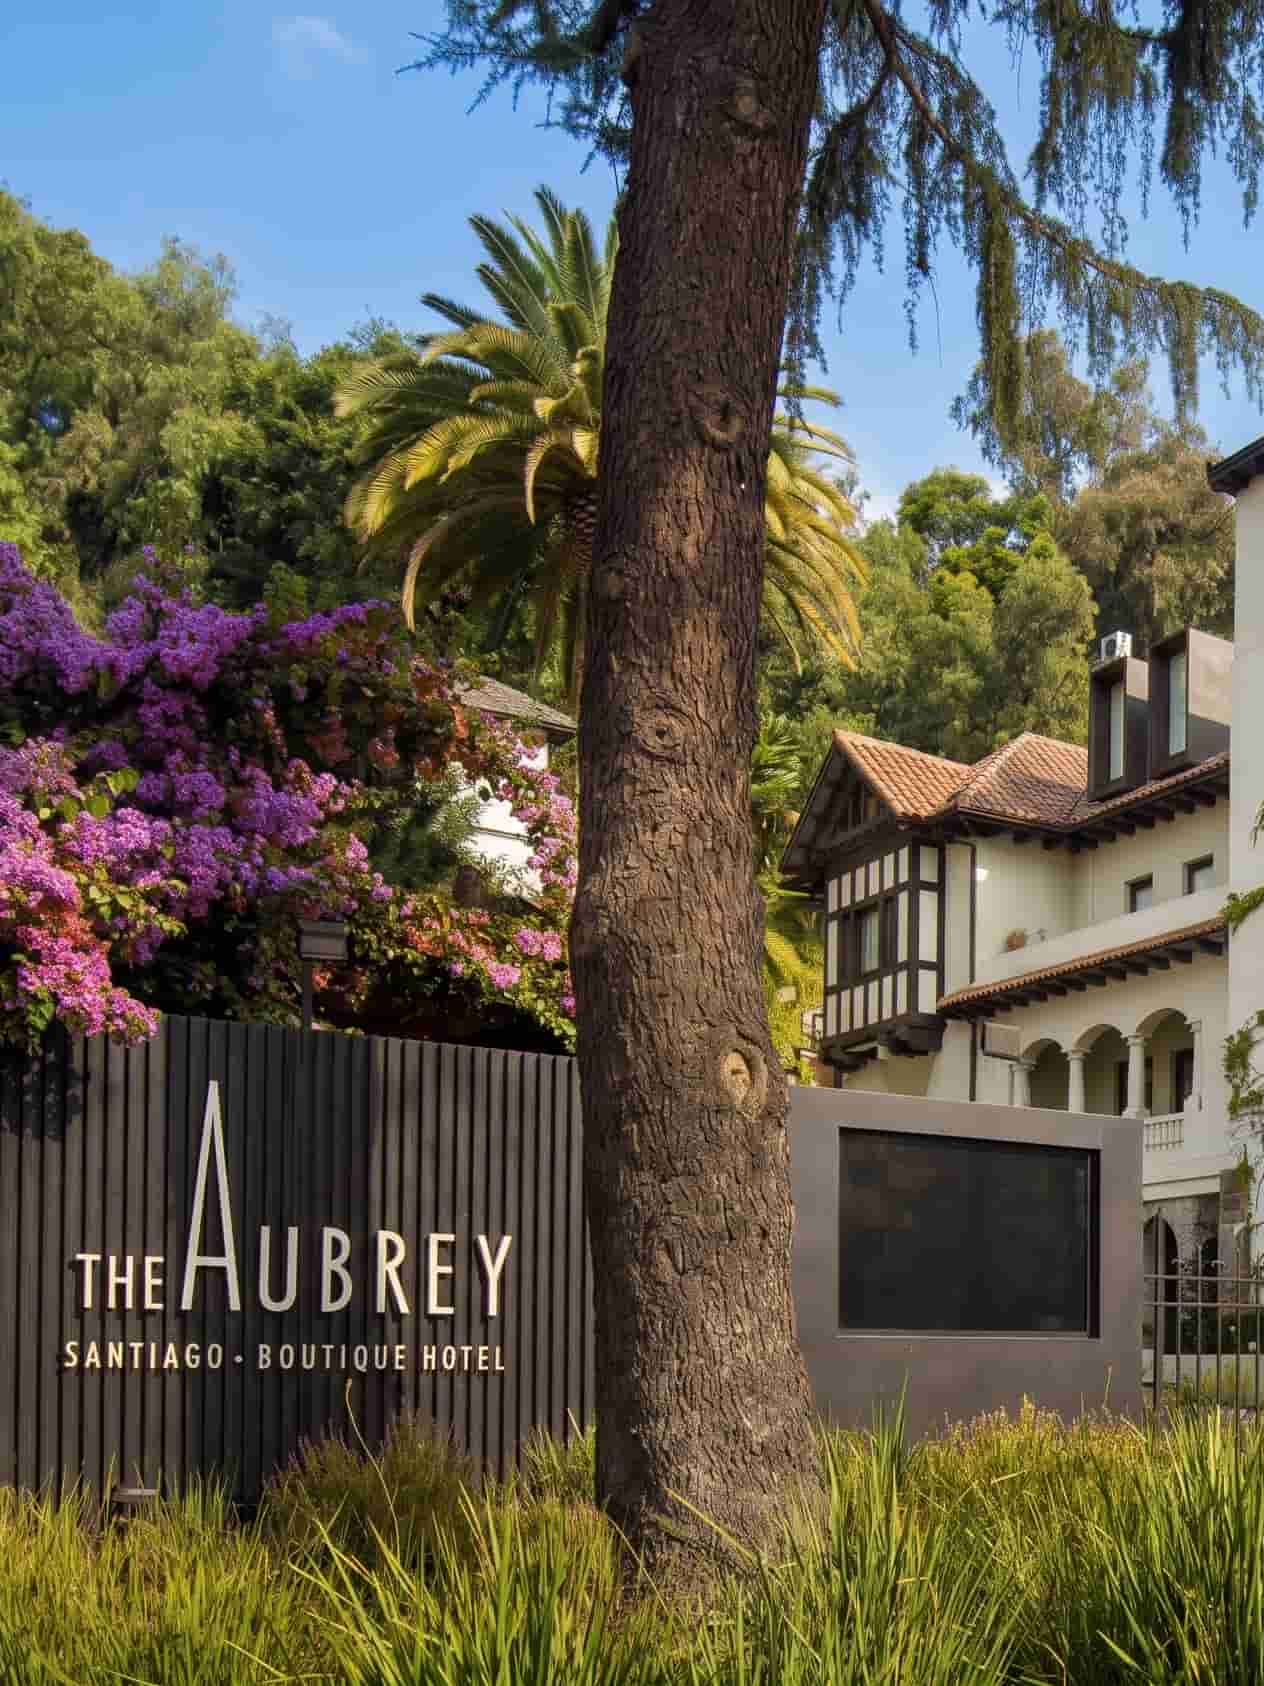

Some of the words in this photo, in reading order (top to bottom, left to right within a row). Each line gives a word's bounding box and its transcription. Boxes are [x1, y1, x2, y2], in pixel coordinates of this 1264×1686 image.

[76, 1253, 165, 1311] THE
[180, 1079, 512, 1317] AUBREY
[64, 1341, 224, 1370] SANTIAGO
[258, 1343, 406, 1373] BOUTIQUE
[423, 1345, 505, 1371] HOTEL
